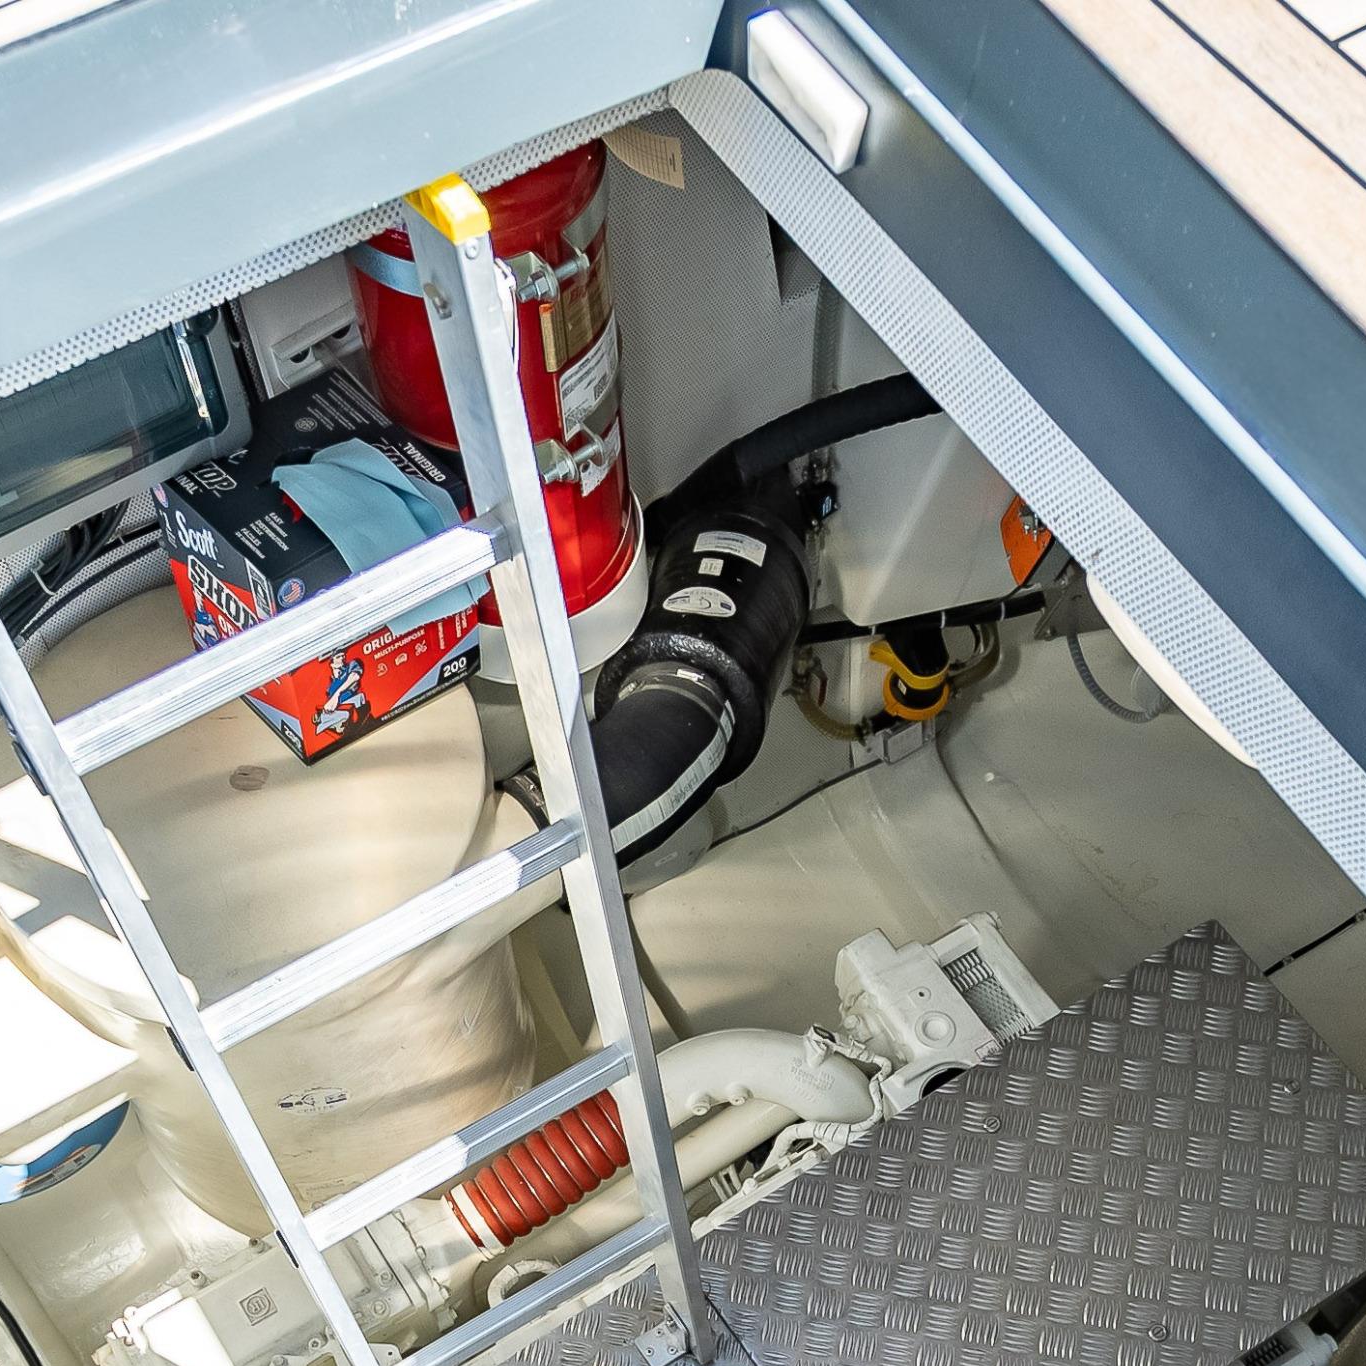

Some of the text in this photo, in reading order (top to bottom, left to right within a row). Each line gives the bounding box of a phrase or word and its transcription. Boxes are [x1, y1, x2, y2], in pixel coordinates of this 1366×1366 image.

[403, 441, 446, 481] ORIGINAL
[176, 510, 217, 561] Scott
[442, 656, 466, 677] 200
